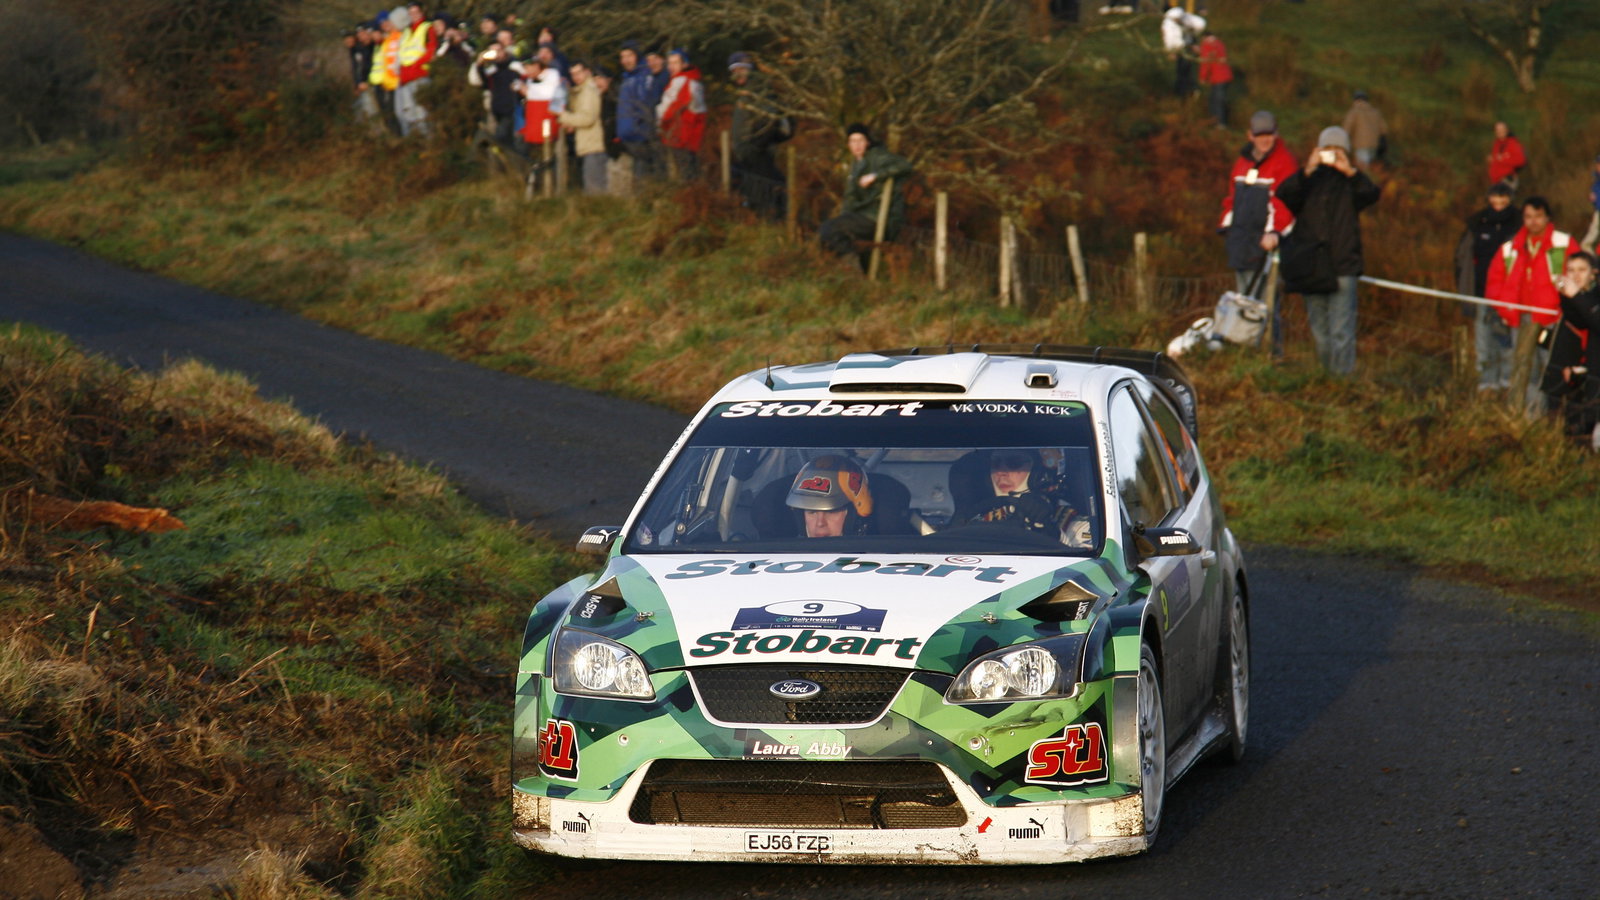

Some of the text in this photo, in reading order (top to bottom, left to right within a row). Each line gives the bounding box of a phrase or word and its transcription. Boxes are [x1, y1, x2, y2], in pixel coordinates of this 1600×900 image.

[721, 400, 924, 418] Stobart
[952, 404, 1071, 416] VK VODKA KICK
[579, 534, 605, 545] PUMA
[1159, 535, 1190, 545] PUMA
[665, 557, 1018, 584] Stobart
[802, 602, 824, 614] 9
[689, 629, 922, 660] Stobart
[780, 682, 809, 693] Ford
[752, 741, 852, 759] Laura Abby
[562, 820, 587, 834] PUMA
[1008, 827, 1040, 839] PUMA
[748, 835, 830, 851] EJ56 FZB
